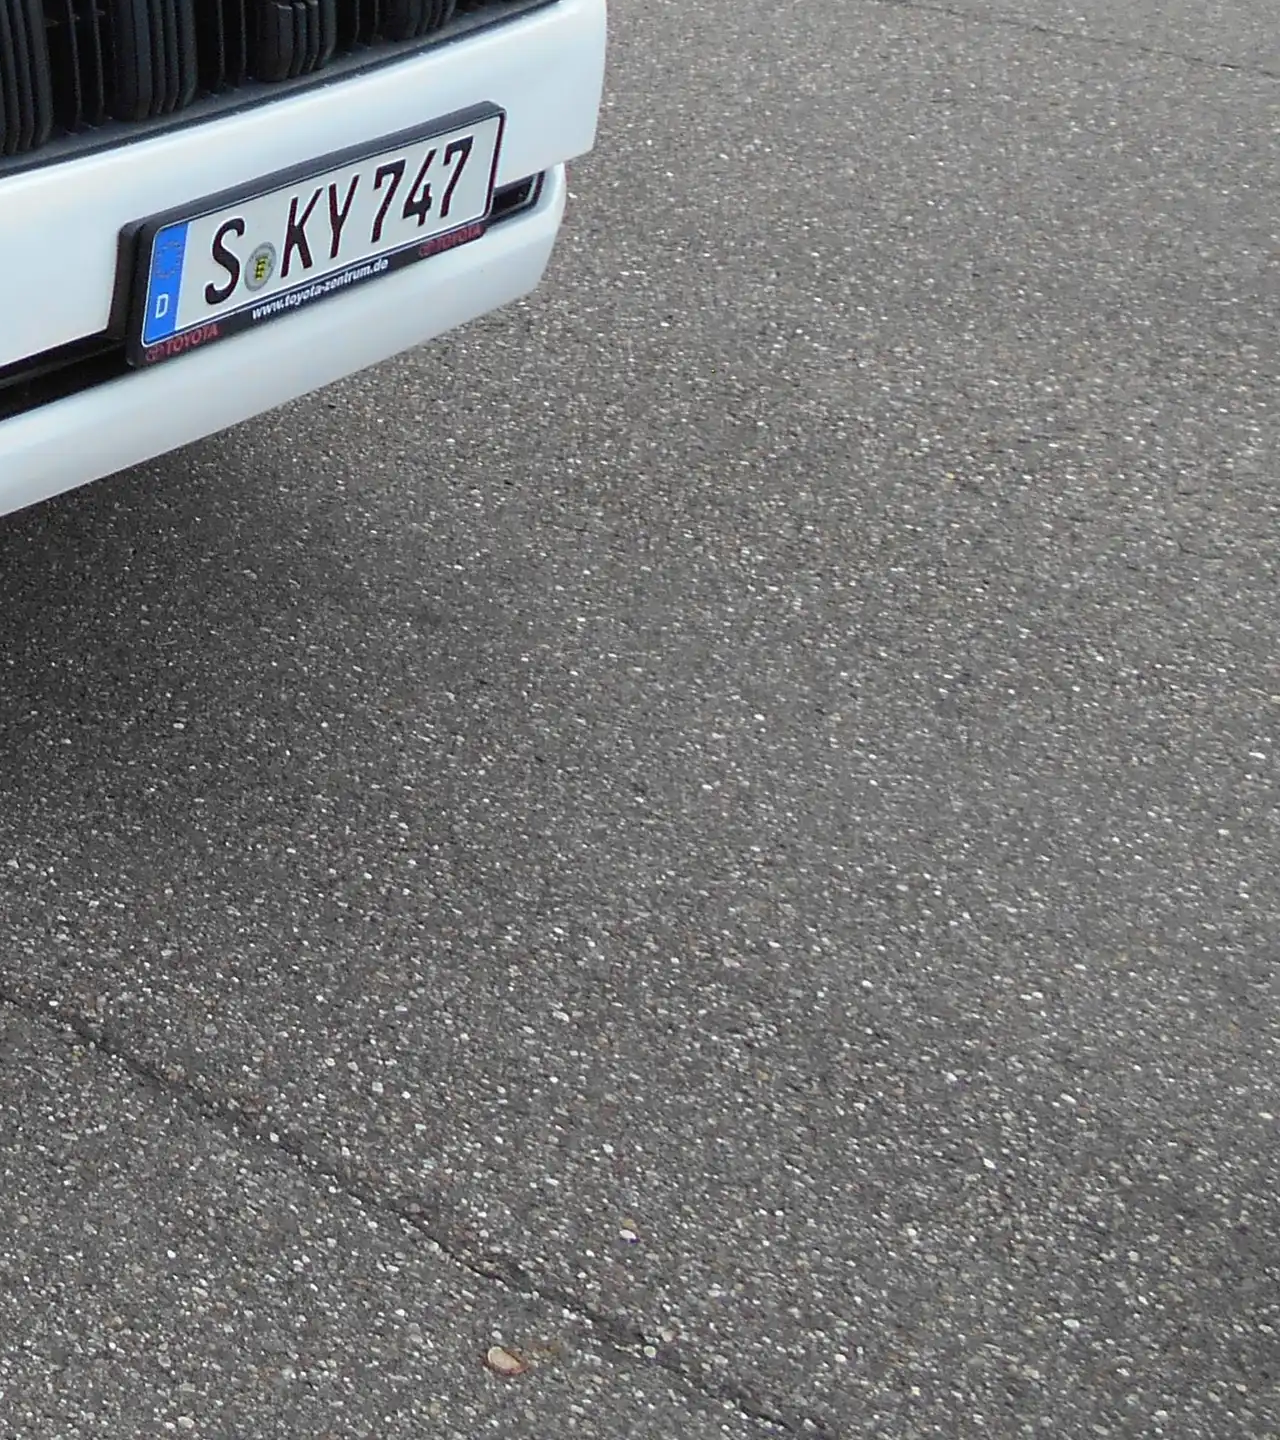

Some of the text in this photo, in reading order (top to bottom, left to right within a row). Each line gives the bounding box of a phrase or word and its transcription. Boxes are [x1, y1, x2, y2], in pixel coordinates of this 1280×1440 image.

[204, 135, 475, 306] S KY 747
[155, 293, 169, 320] D
[251, 258, 389, 320] www.toyota-zentrum.de
[163, 323, 219, 356] TOYOTA
